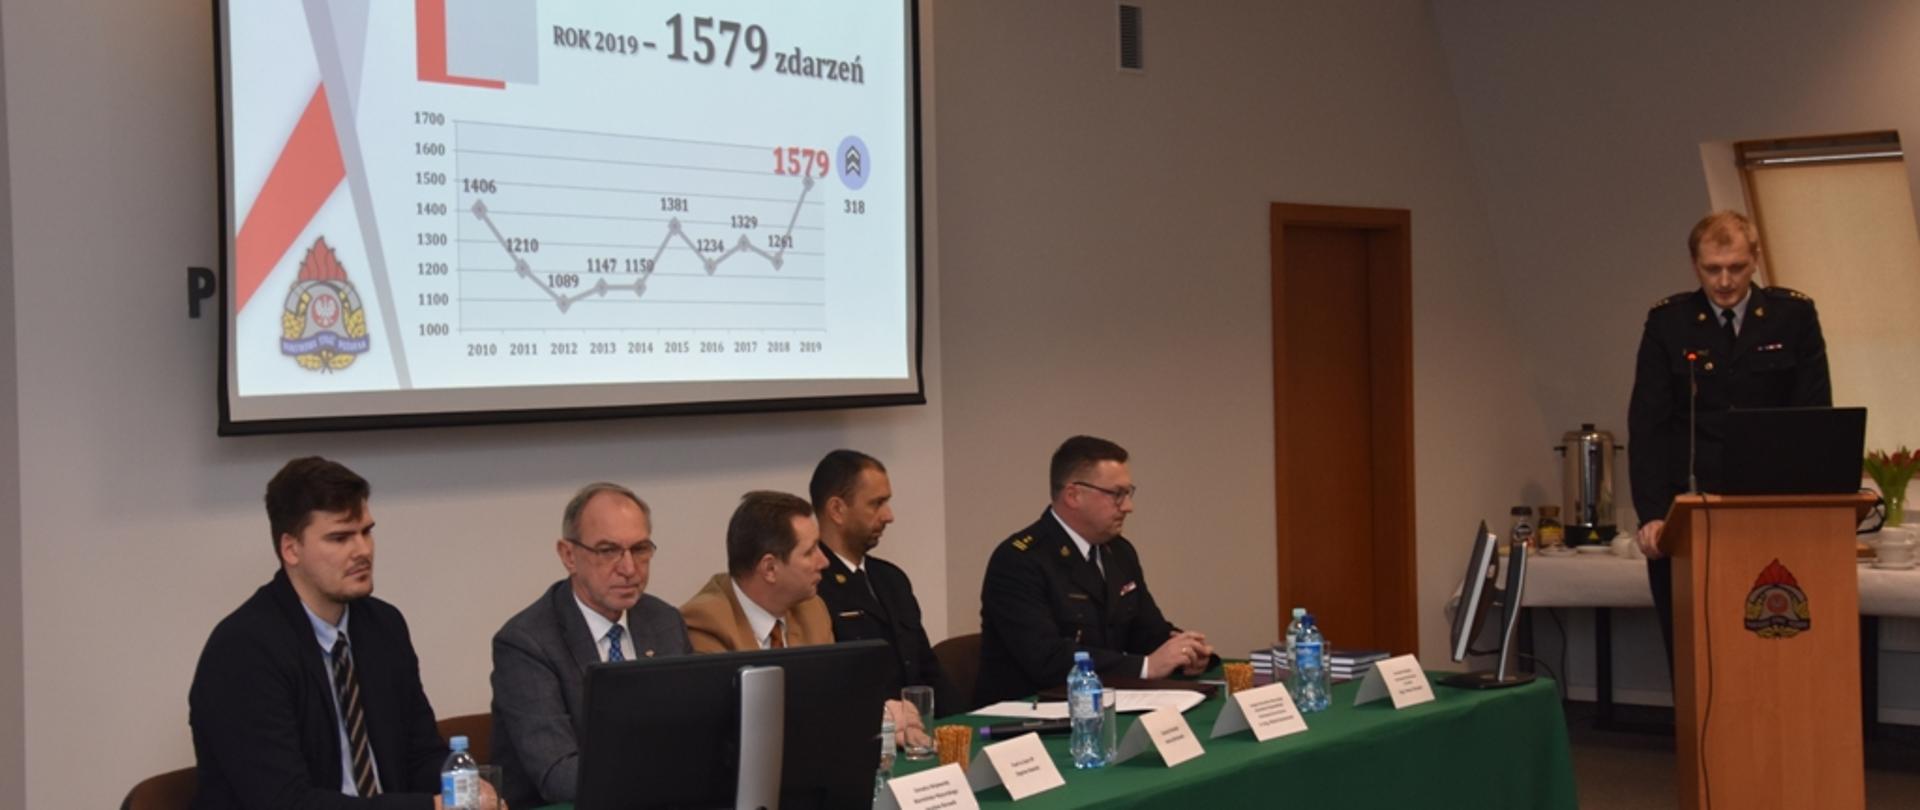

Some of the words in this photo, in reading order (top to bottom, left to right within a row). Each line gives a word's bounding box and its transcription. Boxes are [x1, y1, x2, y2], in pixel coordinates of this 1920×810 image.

[553, 25, 590, 50] ROK
[594, 32, 638, 55] 2019
[665, 13, 768, 70] 1579
[774, 48, 864, 84] zdarzeń
[415, 112, 445, 127] 1700
[415, 142, 445, 157] 1600
[773, 148, 831, 177] 1579
[416, 172, 446, 186] 1500
[463, 178, 496, 194] 1406
[416, 203, 447, 216] 1400
[660, 198, 688, 212] 1381
[844, 200, 865, 214] 318
[731, 215, 758, 229] 1329
[417, 233, 448, 247] 1300
[506, 238, 539, 253] 1210
[697, 239, 724, 253] 1234
[768, 236, 794, 249] 1261
[418, 263, 448, 276] 1200
[587, 259, 617, 273] 1147
[548, 275, 579, 289] 1089
[187, 267, 215, 319] P
[419, 293, 448, 306] 1100
[419, 323, 449, 336] 1000
[467, 344, 497, 357] 2010
[510, 344, 538, 357] 2011
[551, 343, 578, 356] 2012
[590, 342, 616, 355] 2013
[627, 342, 653, 355] 2014
[664, 342, 689, 354] 2015
[700, 342, 724, 354] 2016
[734, 342, 757, 353] 2017
[768, 342, 790, 353] 2018
[800, 341, 822, 353] 2019
